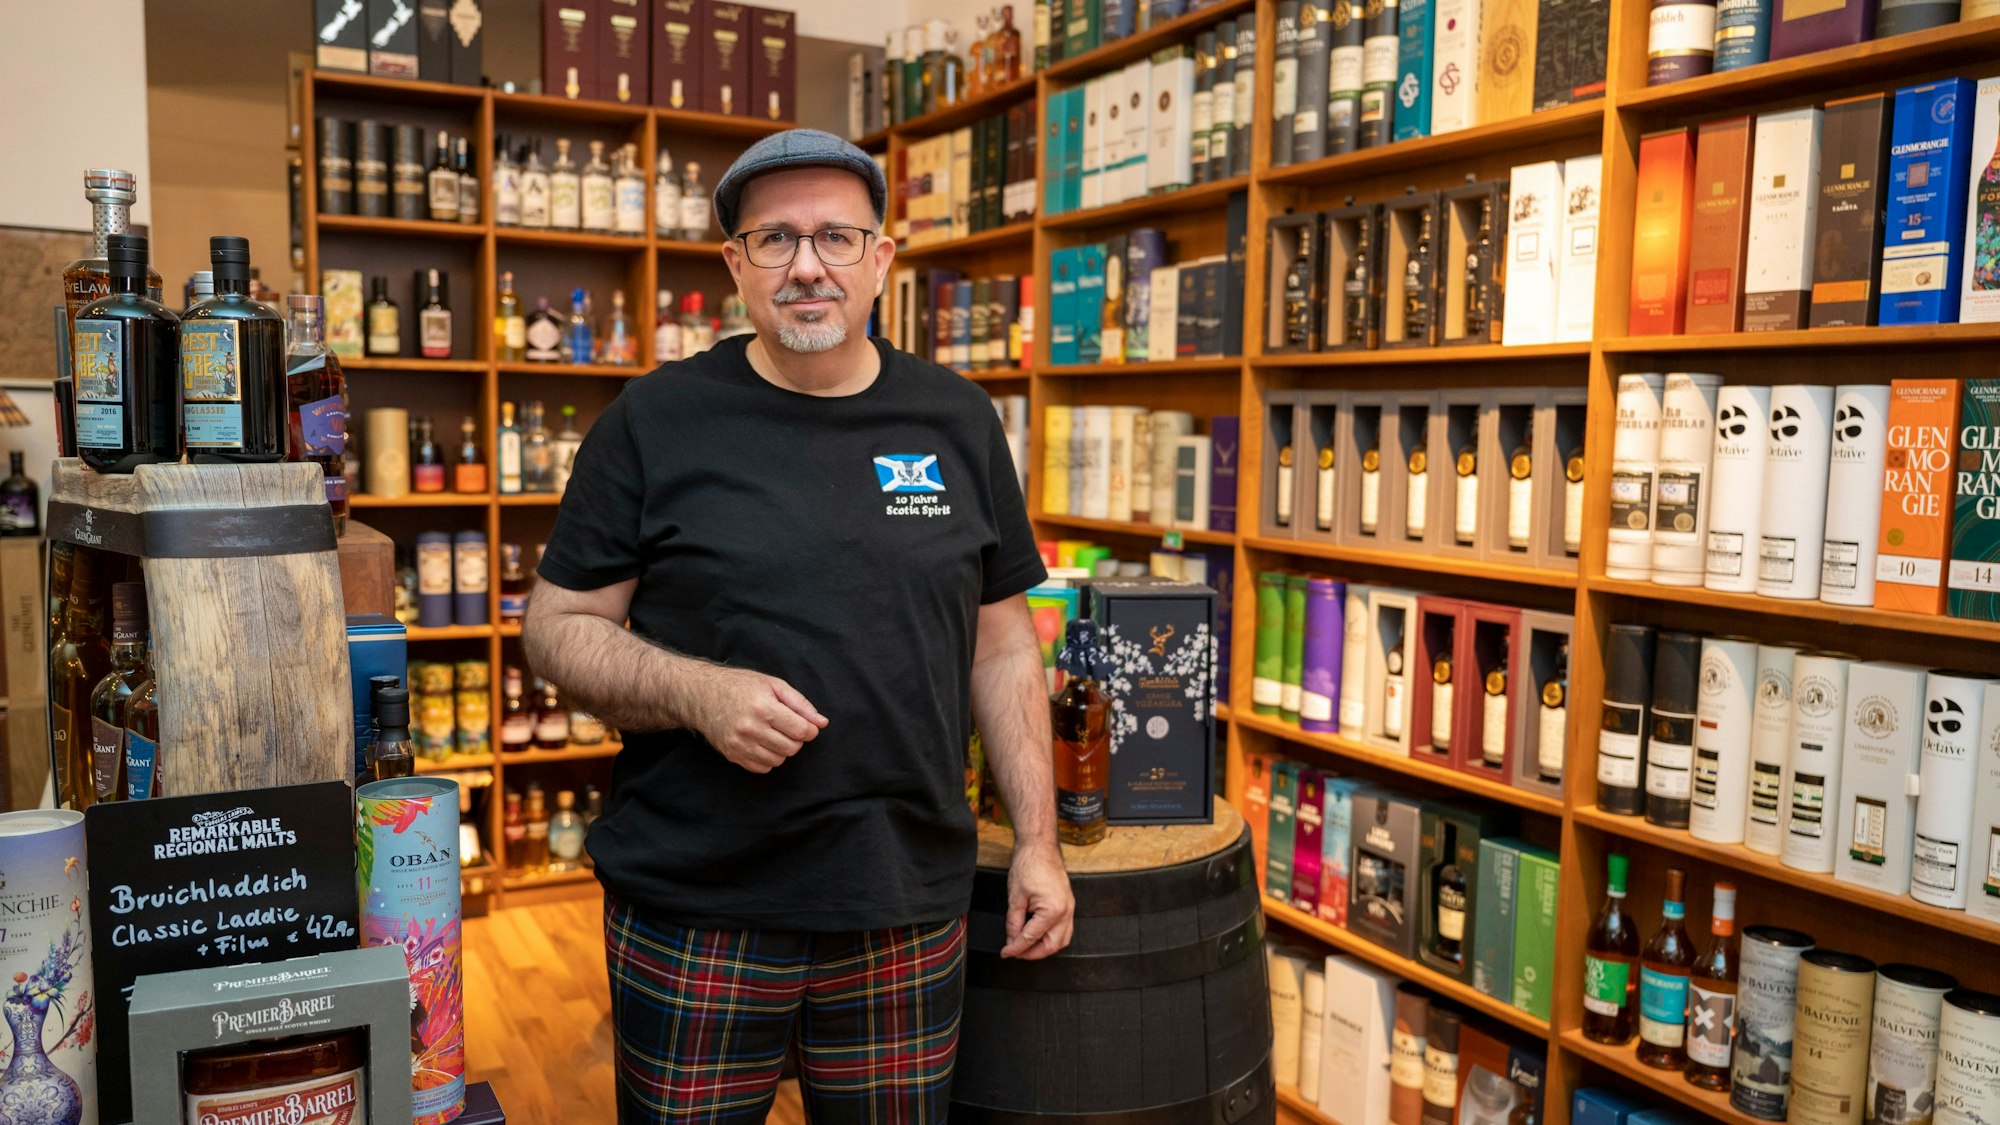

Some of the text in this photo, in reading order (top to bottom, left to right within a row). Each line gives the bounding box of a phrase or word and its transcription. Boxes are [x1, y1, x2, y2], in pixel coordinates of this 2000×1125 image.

[1891, 137, 1949, 156] GLENMORANGIE
[1908, 213, 1921, 226] 15
[1896, 387, 1947, 396] GLENMORANGIE
[101, 407, 117, 415] 2016
[1888, 425, 1949, 449] GLEN
[1906, 449, 1950, 472] MO
[1884, 470, 1932, 493] RAN
[895, 495, 938, 506] 10 Jahre
[1902, 493, 1940, 517] GIE
[886, 505, 951, 518] Scotia Spirit
[1899, 561, 1916, 578] 10
[1974, 567, 1992, 584] 14
[169, 817, 281, 843] REMARKABLE
[154, 830, 297, 860] REGIONAL MALTS
[389, 848, 452, 868] OBAN
[109, 867, 307, 914] Bruichladdich
[418, 876, 431, 890] 11
[112, 907, 299, 947] Classic Laddie
[197, 943, 208, 956] +
[213, 934, 269, 955] Film
[213, 967, 331, 992] PREMIER BARREL
[212, 995, 335, 1039] PREMIER BARREL
[1804, 1006, 1861, 1026] BALVENIE
[217, 1101, 258, 1113] DOUGLAS LAING'S
[285, 1083, 356, 1125] BARREL
[1950, 1095, 1964, 1109] 16
